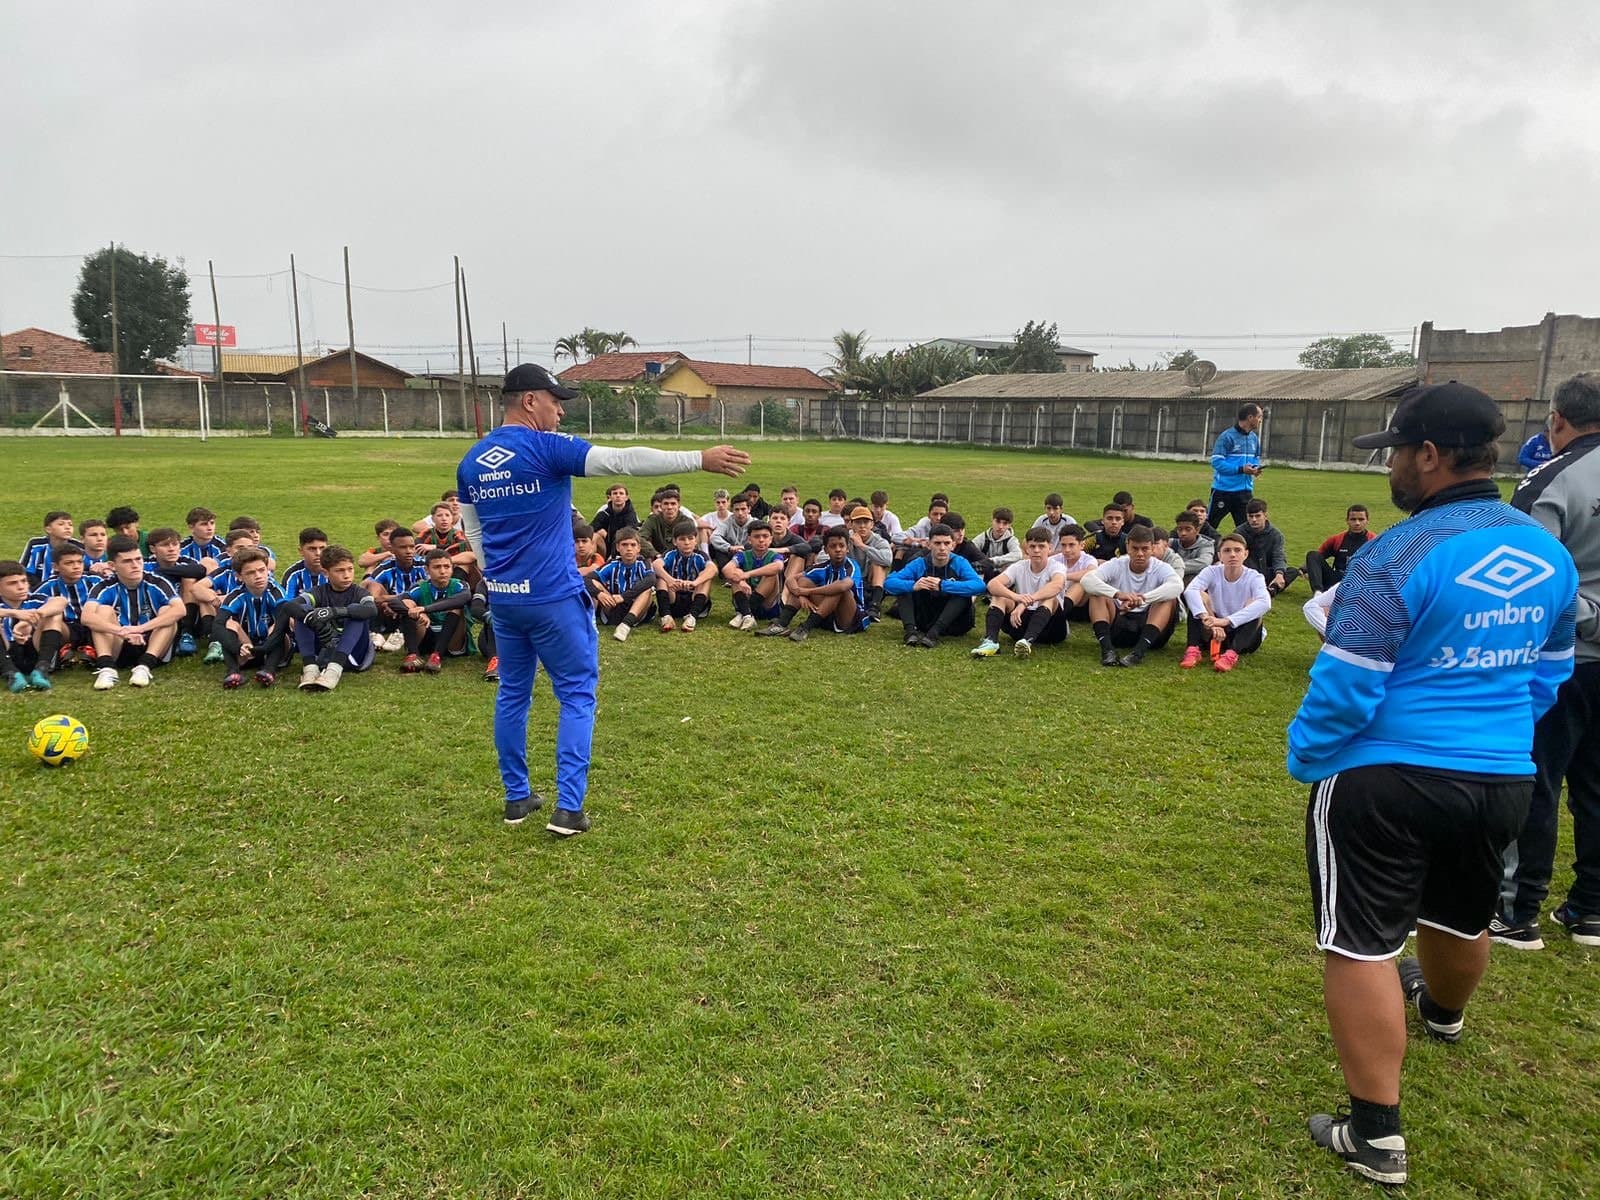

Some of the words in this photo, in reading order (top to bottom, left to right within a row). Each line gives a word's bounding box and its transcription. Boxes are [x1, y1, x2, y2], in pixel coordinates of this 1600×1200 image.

[479, 469, 512, 482] umbro
[479, 479, 541, 499] banrisul
[483, 576, 530, 594] nimed
[1463, 602, 1545, 630] umbro
